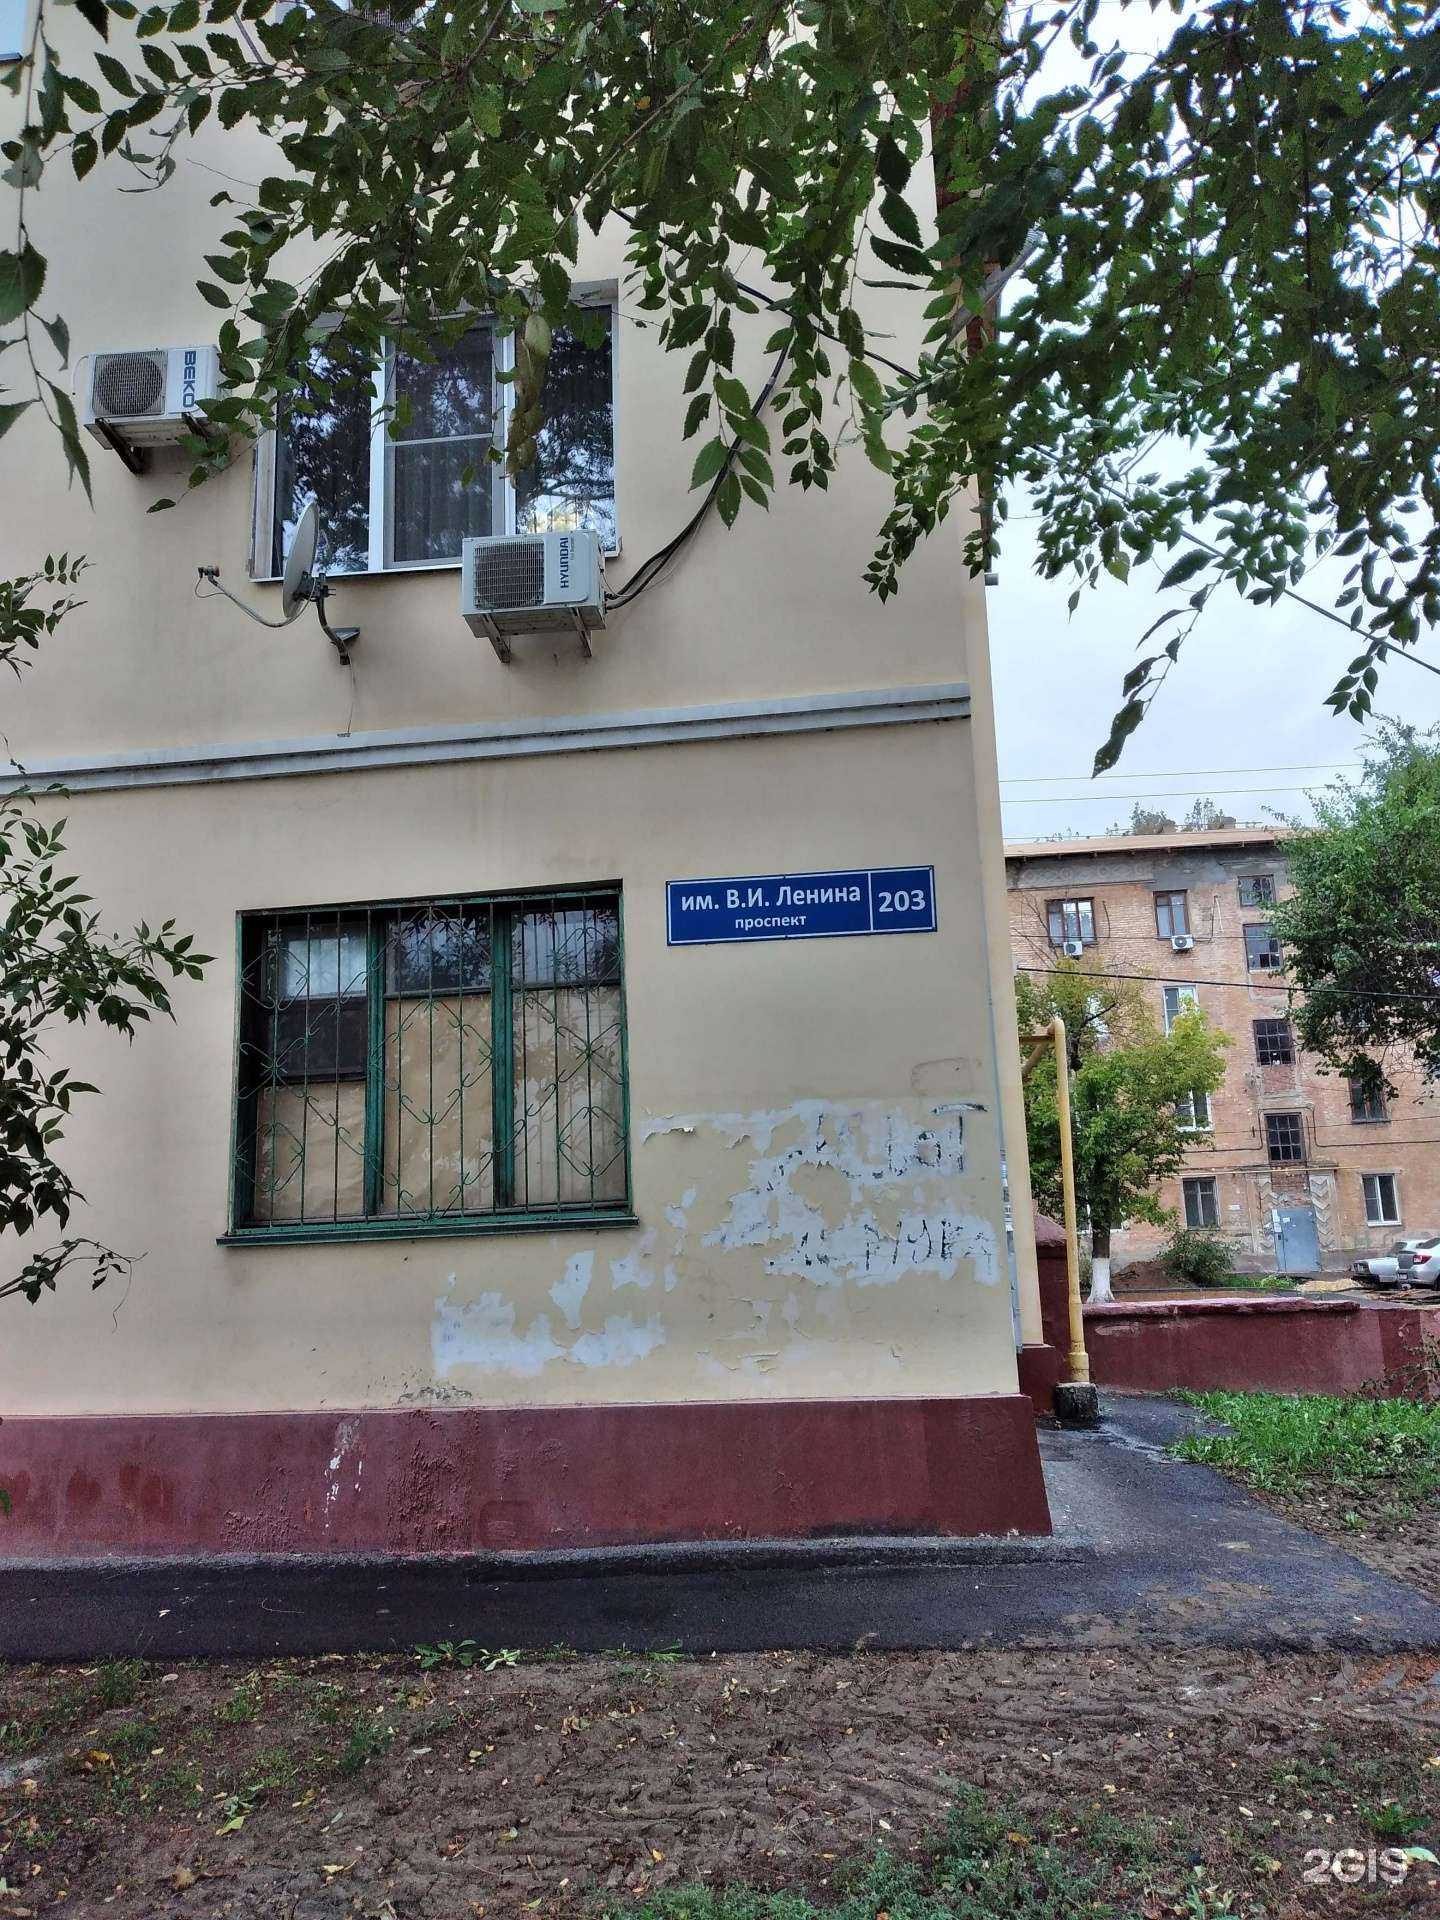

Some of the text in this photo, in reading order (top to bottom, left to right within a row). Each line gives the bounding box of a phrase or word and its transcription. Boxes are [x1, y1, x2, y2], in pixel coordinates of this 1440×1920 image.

[183, 351, 197, 408] BEKO
[560, 537, 569, 589] HYUNDAI
[681, 886, 861, 911] им. В.И. Ленина
[878, 889, 926, 912] 203
[735, 915, 807, 931] проспект
